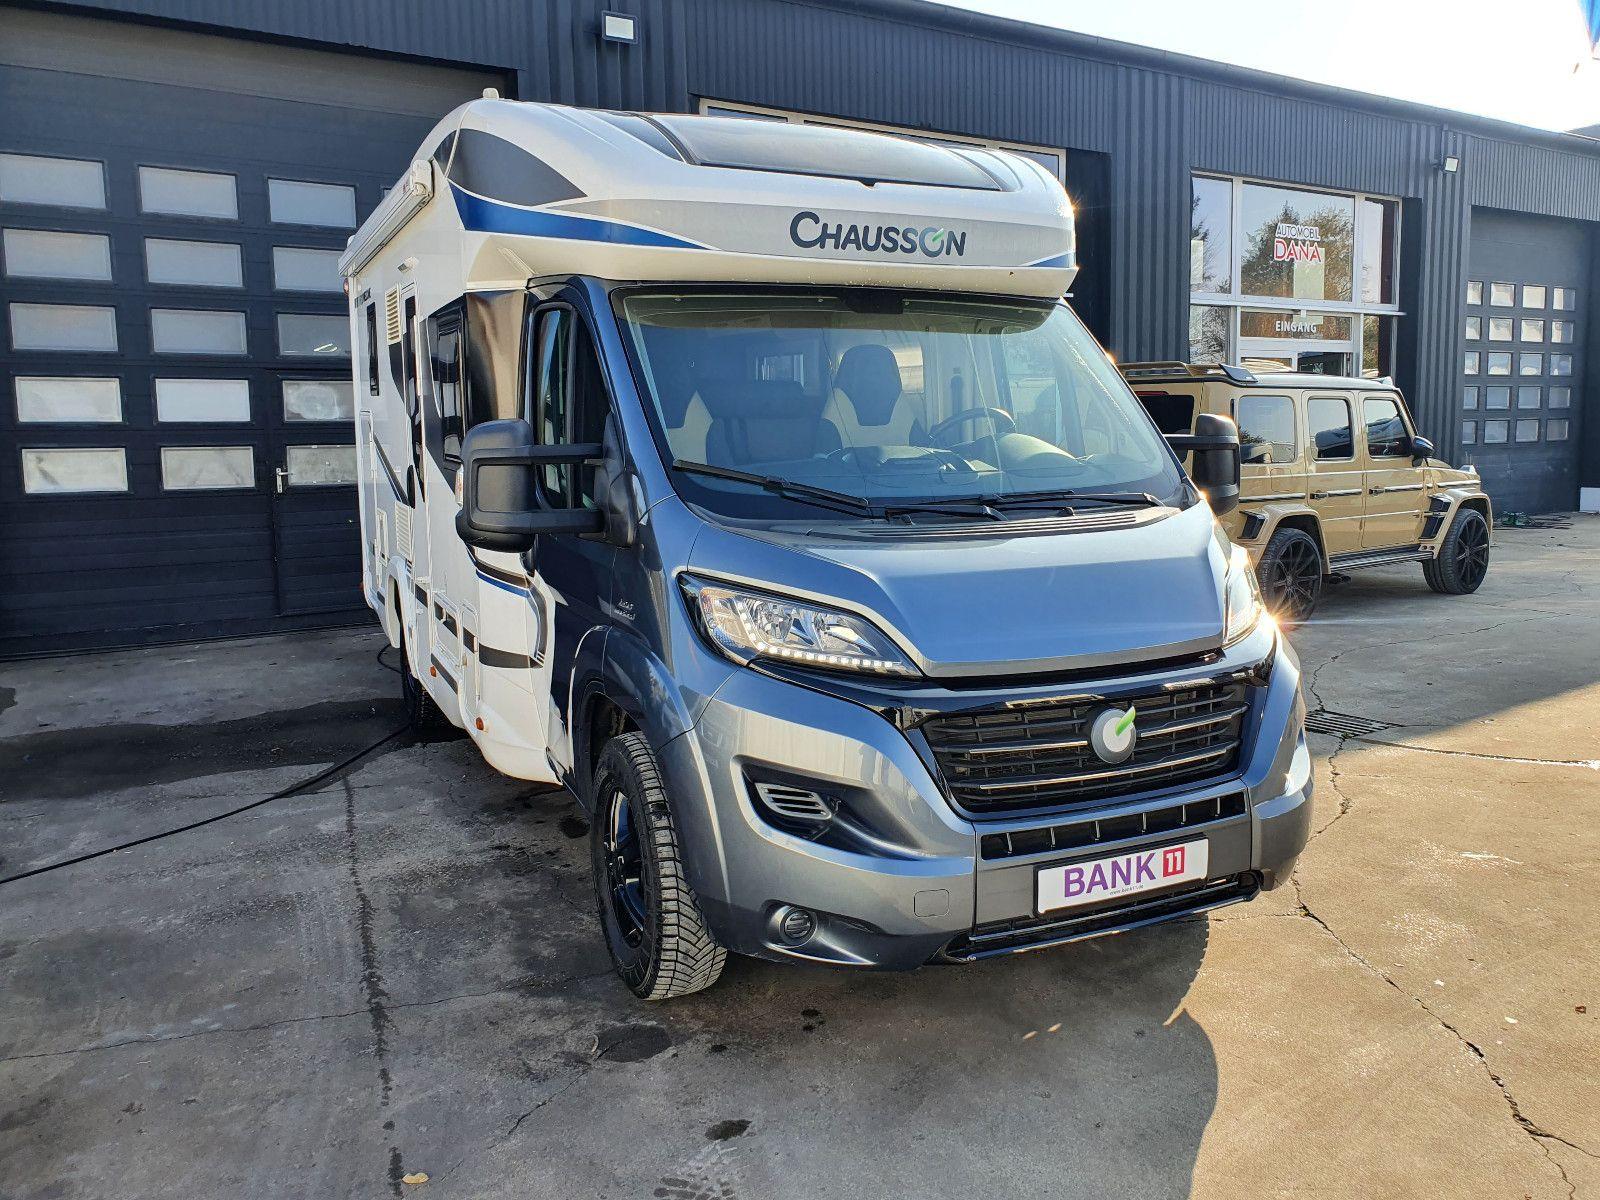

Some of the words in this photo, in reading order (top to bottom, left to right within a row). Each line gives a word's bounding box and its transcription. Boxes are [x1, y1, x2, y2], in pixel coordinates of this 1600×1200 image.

[790, 211, 967, 258] CHAUSSON
[1276, 224, 1320, 241] AUTOMOBIL
[1274, 239, 1322, 262] DANA
[1275, 320, 1317, 333] EINGANG
[1064, 852, 1157, 898] BANK
[1165, 850, 1183, 874] 11
